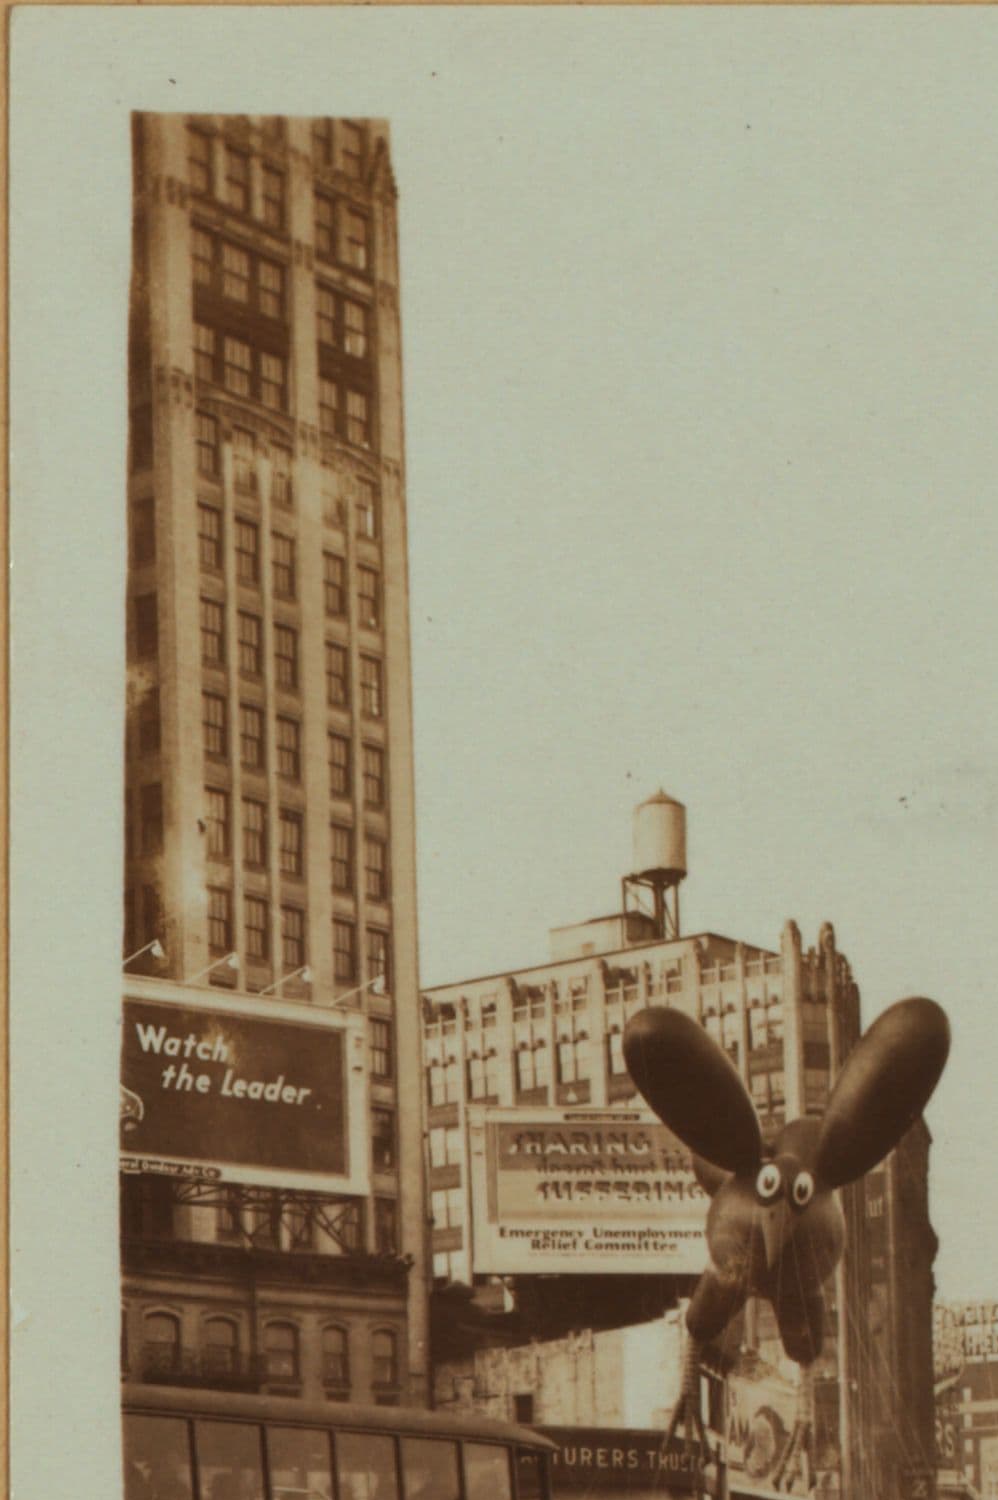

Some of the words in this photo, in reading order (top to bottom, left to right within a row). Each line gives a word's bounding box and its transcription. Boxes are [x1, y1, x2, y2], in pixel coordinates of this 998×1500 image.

[135, 1022, 229, 1063] Watch
[162, 1063, 211, 1094] the
[220, 1068, 312, 1105] Leader
[499, 1226, 585, 1241] Emergency
[531, 1238, 578, 1251] Relief
[584, 1238, 678, 1251] Committee
